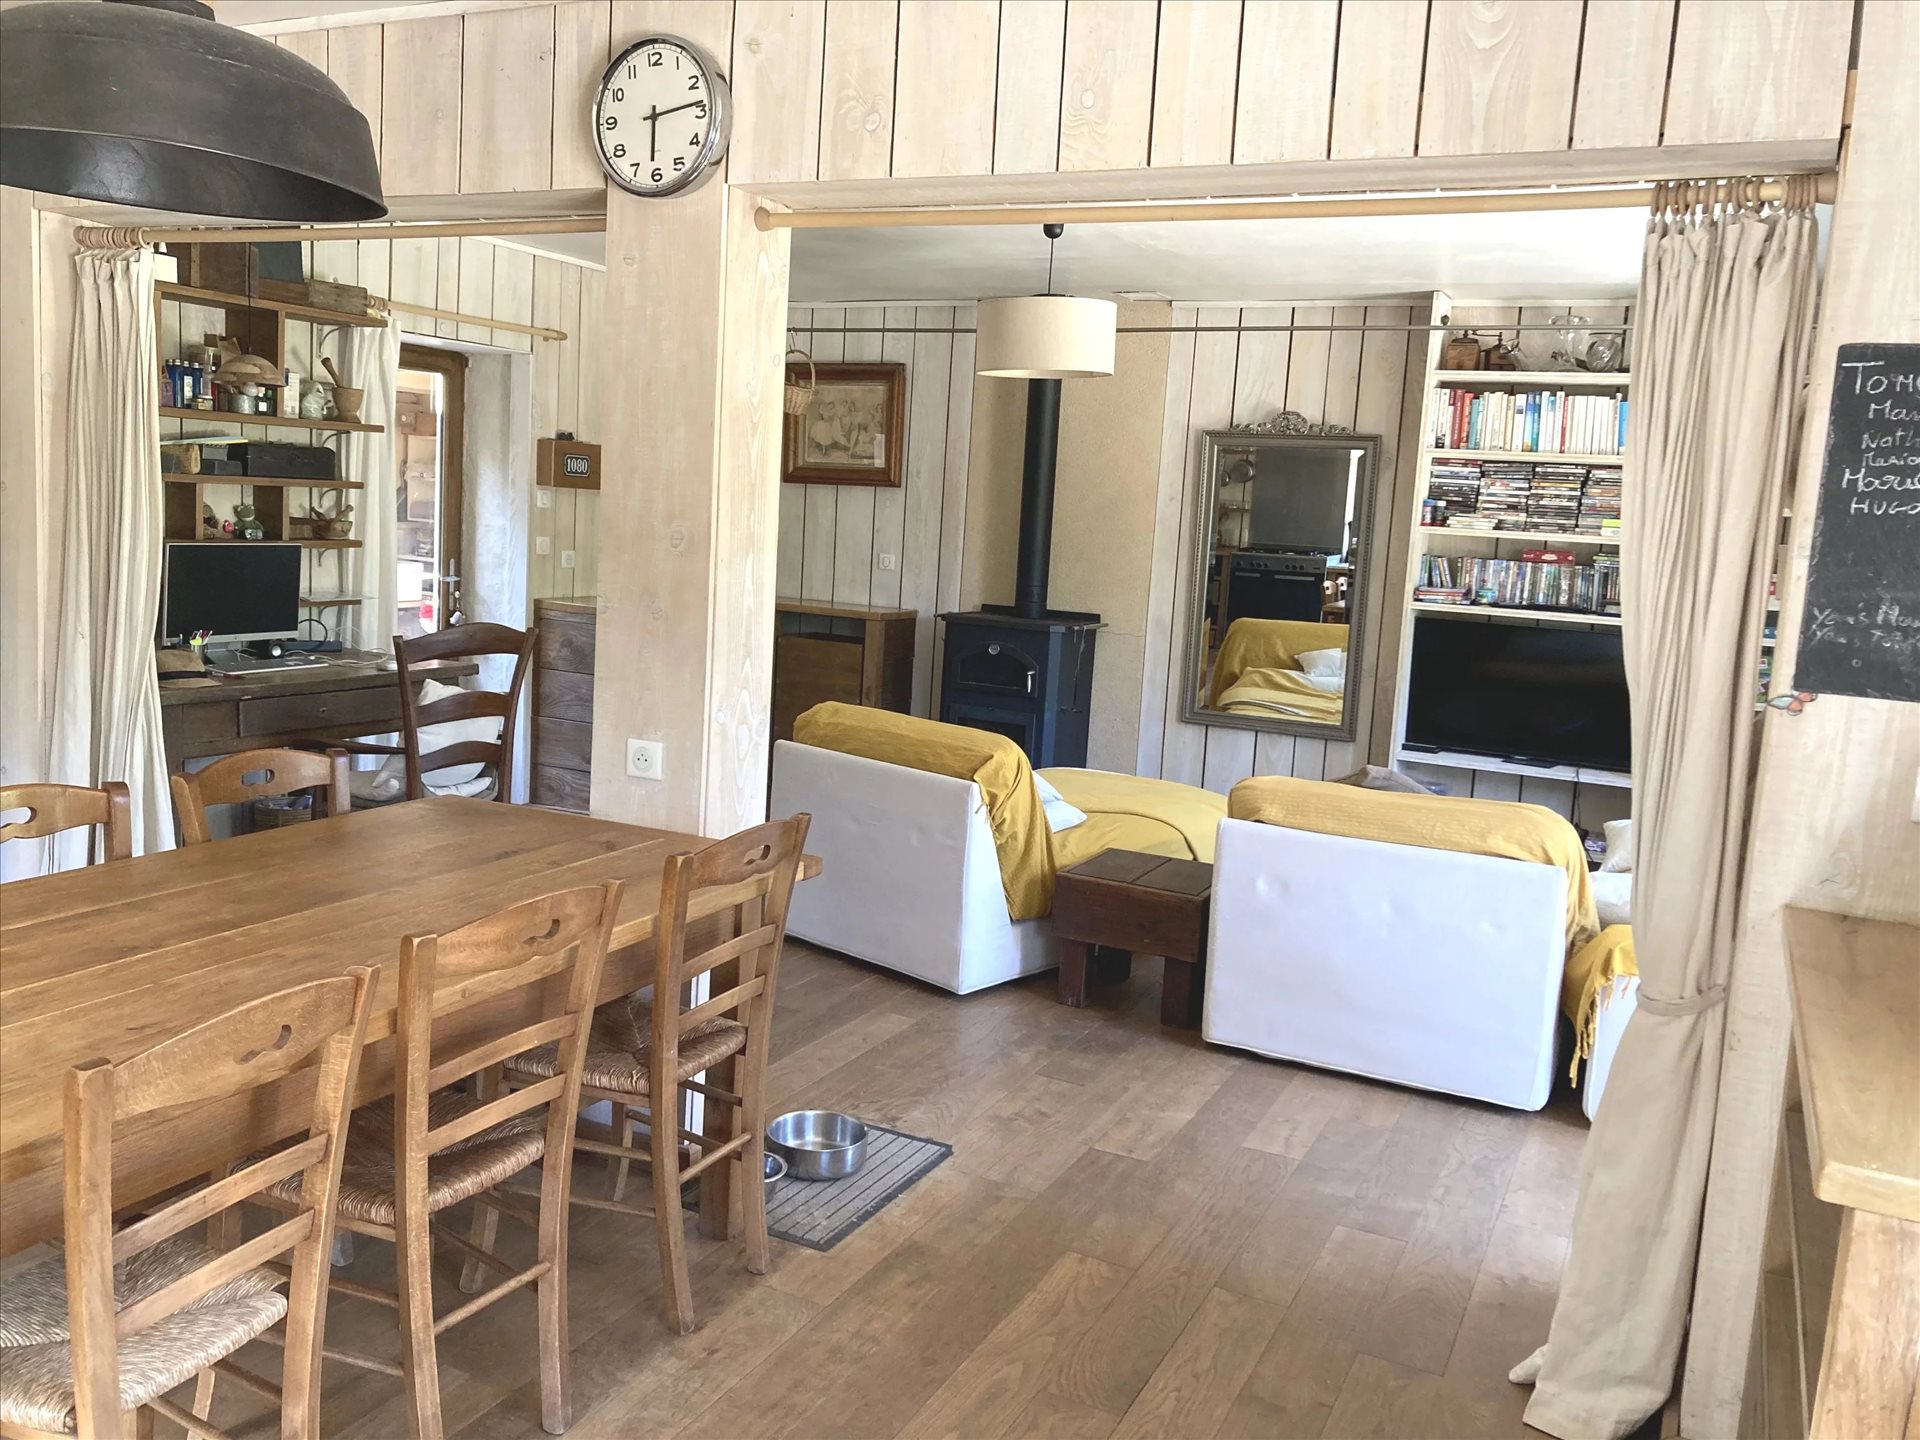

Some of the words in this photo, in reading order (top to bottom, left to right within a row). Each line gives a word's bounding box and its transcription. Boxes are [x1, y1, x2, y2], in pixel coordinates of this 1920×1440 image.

[647, 52, 664, 68] 12
[627, 64, 637, 80] 11
[687, 75, 700, 90] 2
[612, 87, 625, 103] 10
[694, 102, 708, 120] 3
[605, 116, 618, 131] 9
[689, 132, 701, 147] 4
[613, 143, 627, 158] 8
[629, 162, 641, 178] 7
[673, 156, 686, 172] 5
[650, 167, 663, 183] 6
[566, 458, 588, 473] 1080
